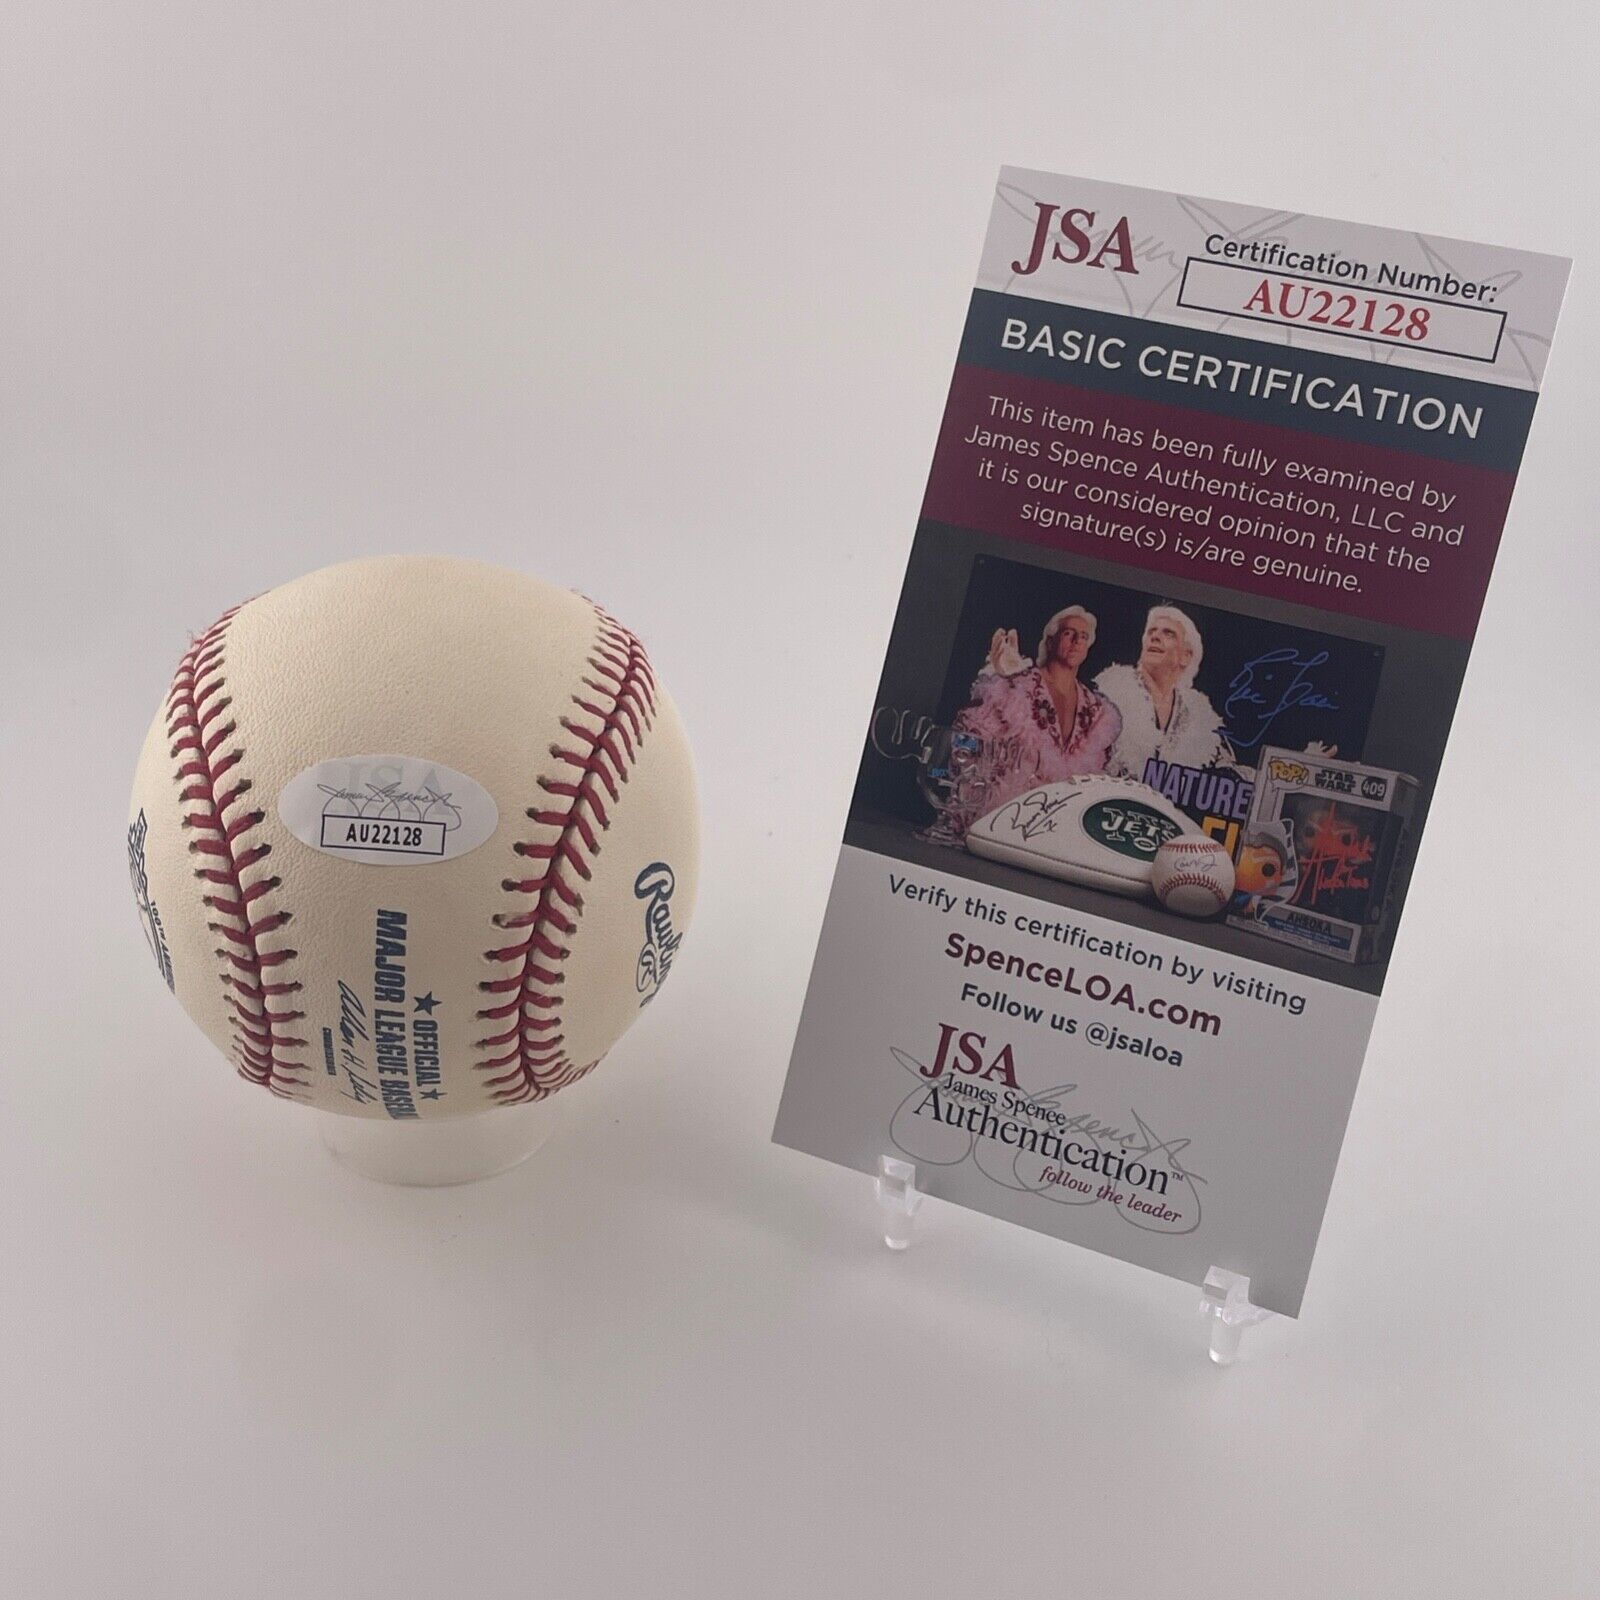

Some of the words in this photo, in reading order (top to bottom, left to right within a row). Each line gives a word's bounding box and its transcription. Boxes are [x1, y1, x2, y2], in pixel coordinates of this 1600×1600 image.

[1011, 201, 1140, 276] JSA
[1204, 233, 1368, 282] Certification
[1377, 263, 1498, 303] Number:
[1243, 278, 1431, 343] AU22128
[1001, 318, 1126, 370] BASIC
[1138, 345, 1484, 440] CERTIFICATION
[964, 424, 1041, 457] James
[1048, 441, 1138, 478] Spence
[1145, 462, 1341, 524] Authentication,
[1351, 503, 1405, 533] LLC
[1411, 521, 1465, 546] and
[989, 395, 1035, 425] This
[1041, 406, 1094, 436] item
[1102, 419, 1144, 446] has
[1151, 428, 1214, 461] been
[1222, 443, 1277, 476] fully
[1285, 461, 1415, 502] examined
[1421, 483, 1456, 513] by
[978, 457, 995, 479] it
[1001, 462, 1020, 485] is
[1026, 473, 1068, 495] our
[1074, 483, 1213, 527] considered
[1219, 514, 1316, 549] opinion
[1325, 532, 1379, 562] that
[1387, 546, 1431, 573] the
[1020, 501, 1167, 552] signature(s)
[1174, 532, 1246, 567] is/are
[1252, 554, 1362, 593] genuine.
[1142, 757, 1255, 821] NATURE
[1363, 779, 1386, 797] 409
[345, 822, 423, 847] AU22128
[374, 908, 408, 1004] MAJOR
[888, 873, 958, 913] Verify
[965, 895, 1007, 926] this
[1014, 912, 1164, 972] certification
[1171, 955, 1205, 985] by
[1212, 968, 1307, 1016] visiting
[944, 932, 1223, 1037] SpenceLOA.com
[374, 1008, 409, 1076] LEAGUE
[413, 1019, 441, 1087] OFFICIAL
[919, 1022, 1021, 1090] JSA
[961, 982, 1044, 1024] Follow
[1050, 1014, 1078, 1035] us
[1085, 1021, 1184, 1068] @jsaloa
[944, 1072, 998, 1105] James
[1002, 1090, 1066, 1126] Spence
[1038, 1165, 1093, 1195] follow
[1096, 1185, 1122, 1205] the
[1127, 1193, 1182, 1224] leader
